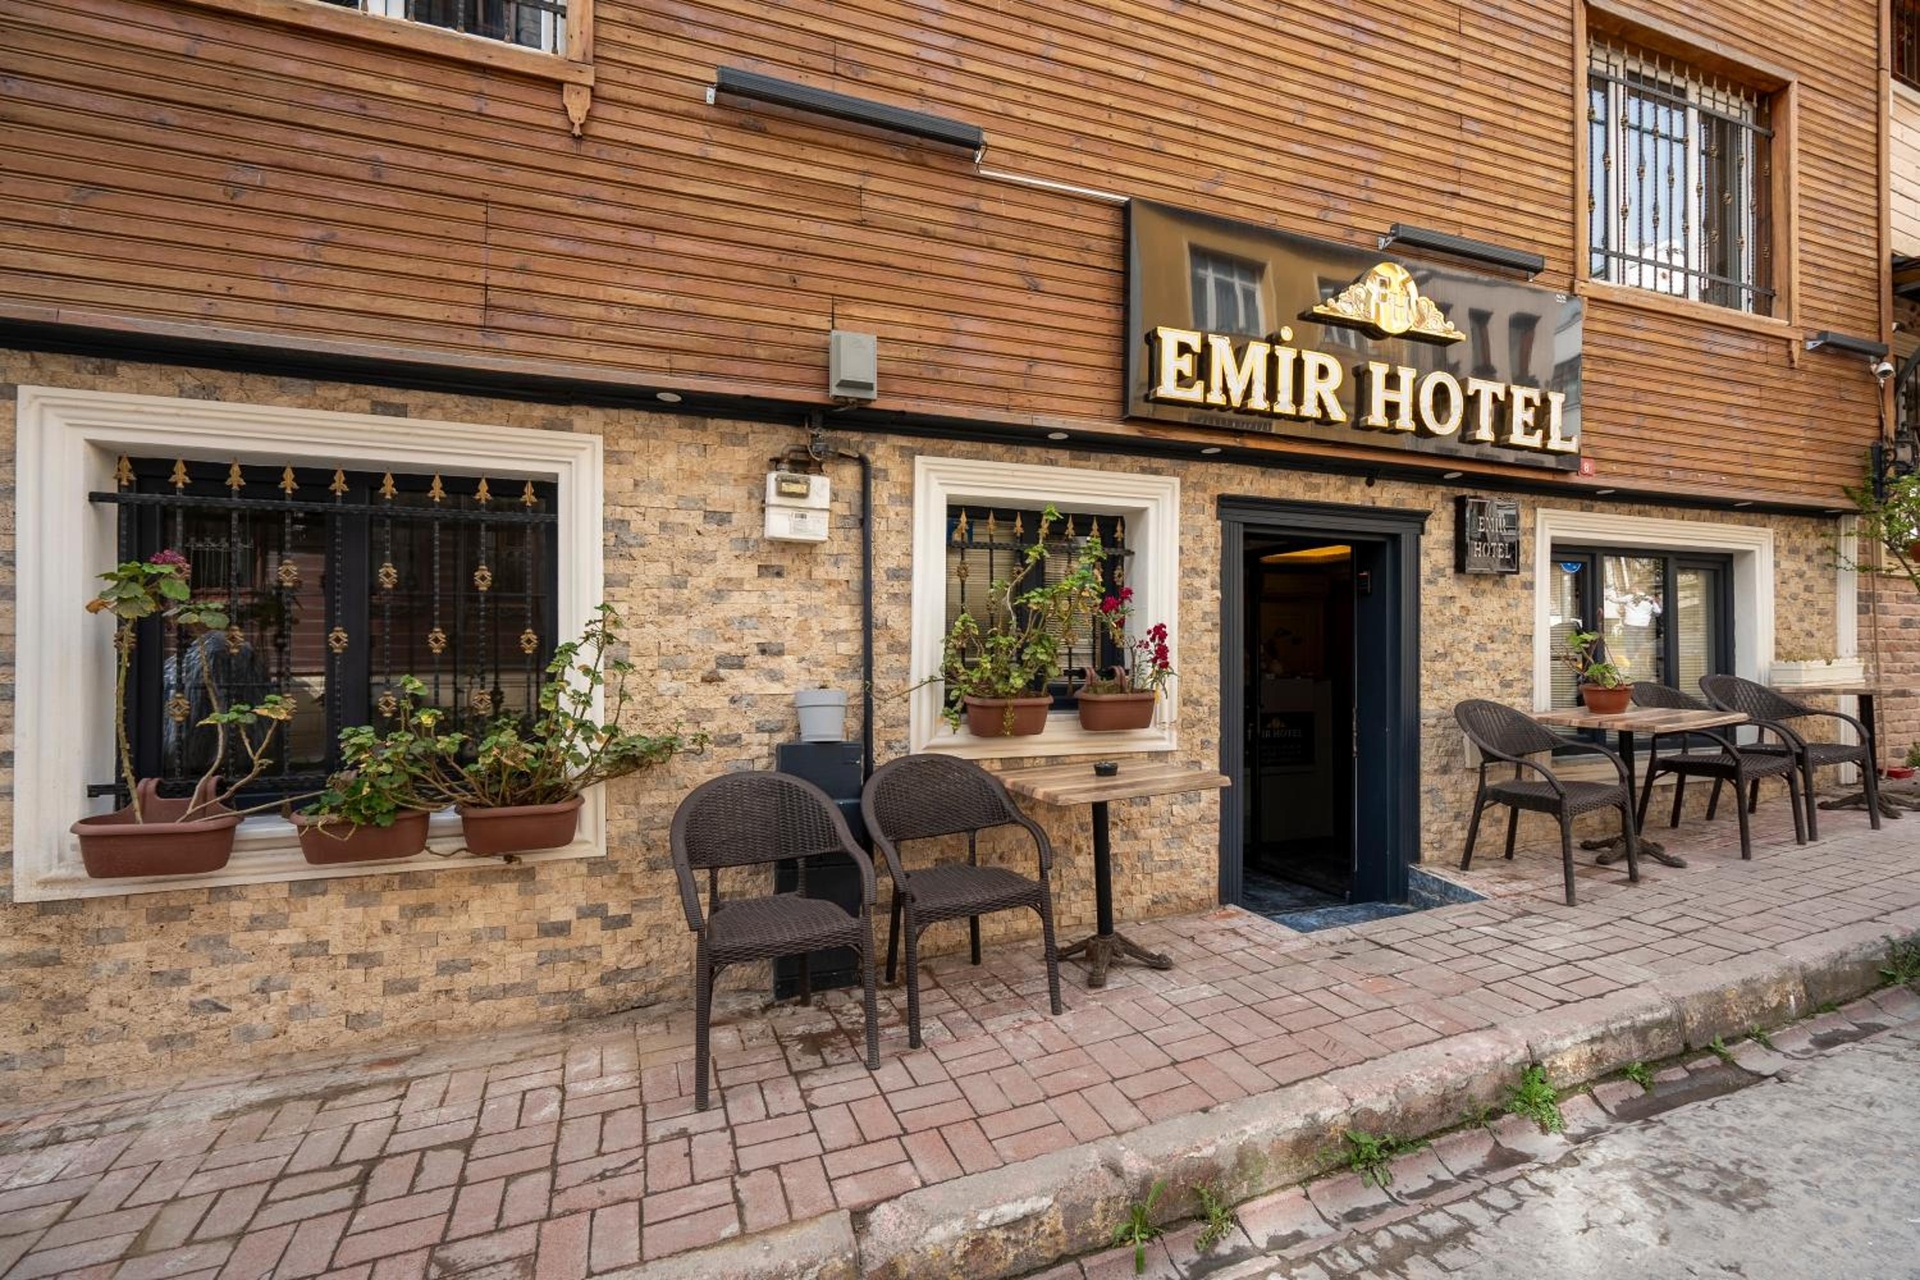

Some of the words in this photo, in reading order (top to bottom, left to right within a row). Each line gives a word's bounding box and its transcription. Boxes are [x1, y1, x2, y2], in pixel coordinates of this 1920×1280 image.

[1156, 326, 1347, 423] EMİR
[1367, 361, 1578, 453] HOTEL
[1474, 541, 1511, 559] HOTEL
